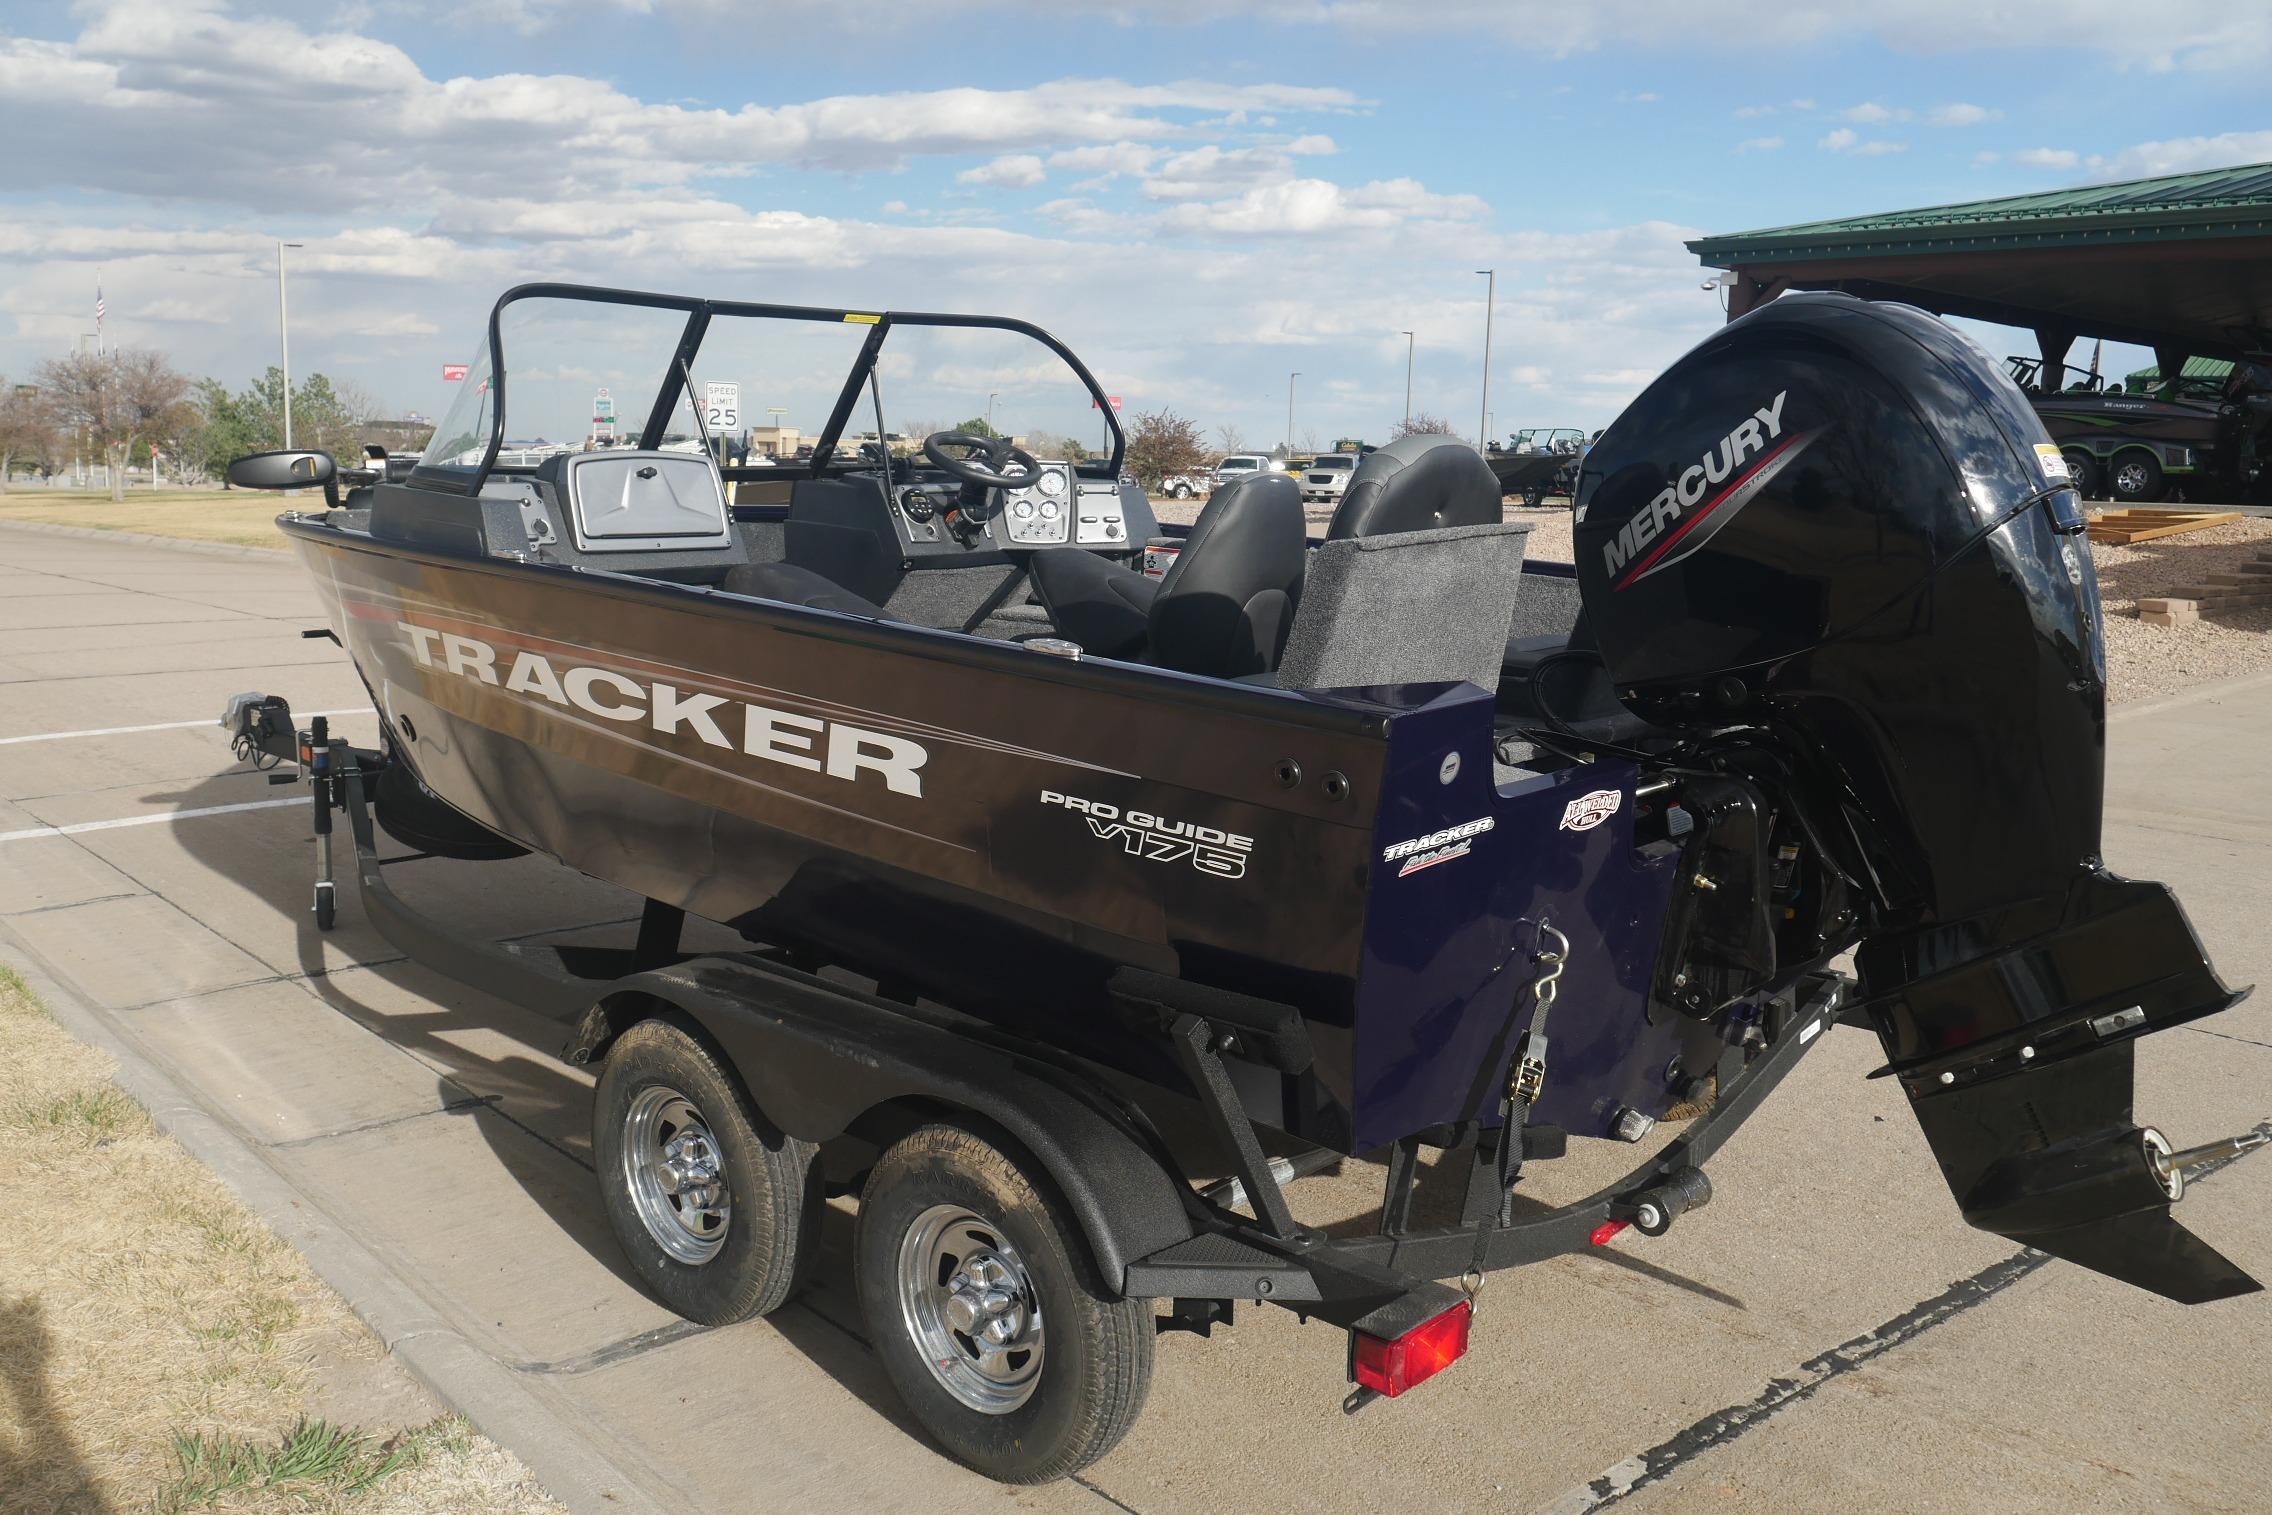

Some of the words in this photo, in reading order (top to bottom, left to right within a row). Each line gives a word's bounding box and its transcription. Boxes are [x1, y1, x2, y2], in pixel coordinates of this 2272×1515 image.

[708, 386, 736, 396] SPEED
[711, 398, 733, 406] LIMIT
[708, 408, 737, 426] 25
[1602, 389, 1787, 579] MERCURY
[396, 620, 928, 799] TRACKER
[1040, 789, 1119, 820] PRO
[1125, 811, 1254, 852] GUIDE
[1564, 802, 1583, 822] ALL
[1584, 794, 1619, 813] WELDED
[1085, 817, 1246, 879] V175
[1384, 817, 1495, 862] TRACKER
